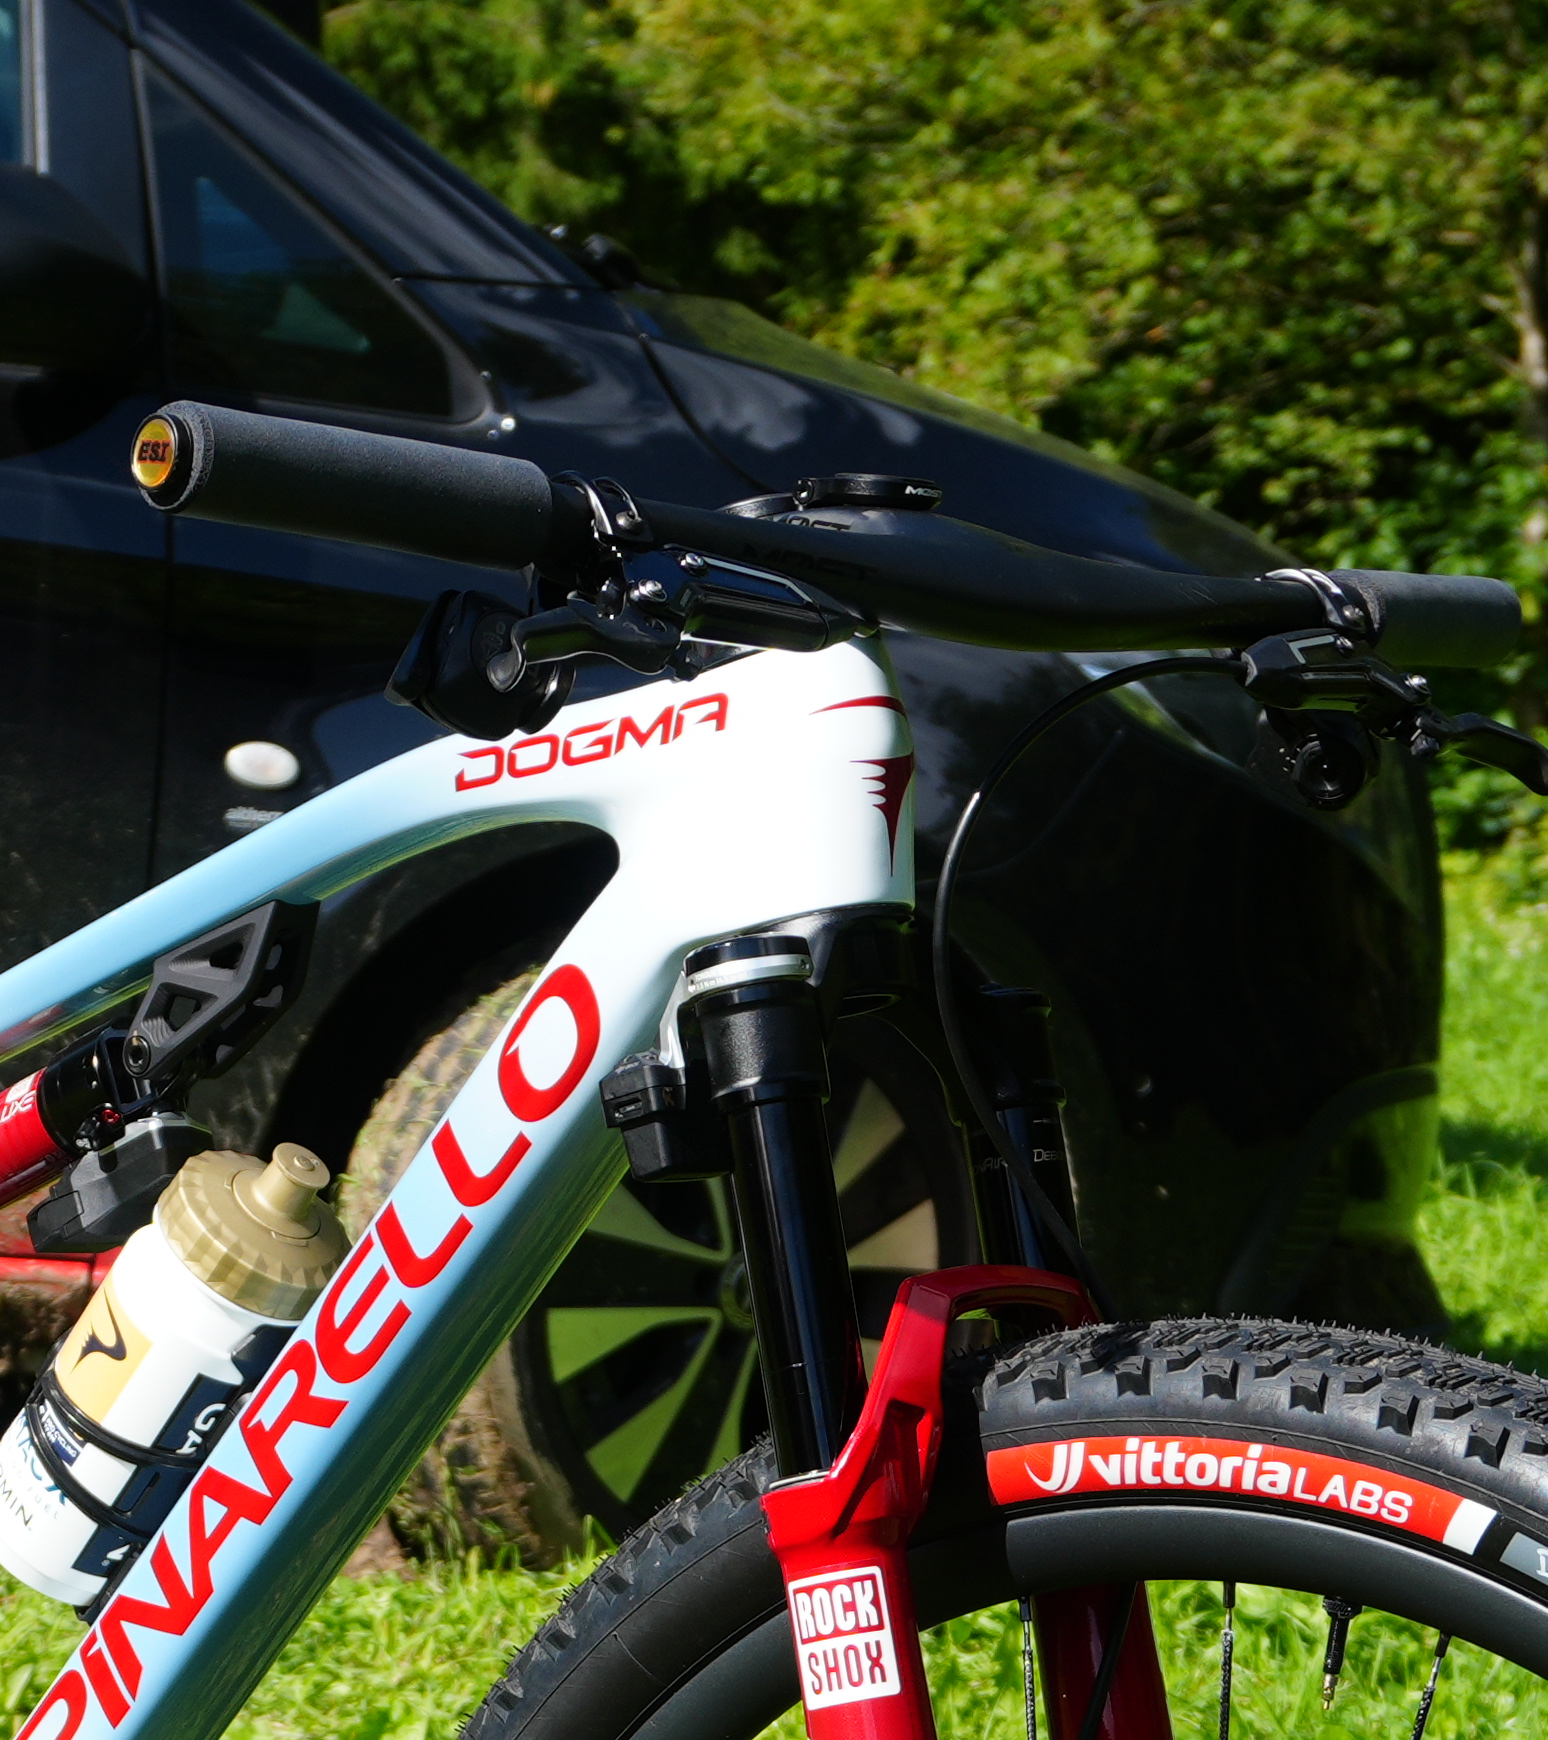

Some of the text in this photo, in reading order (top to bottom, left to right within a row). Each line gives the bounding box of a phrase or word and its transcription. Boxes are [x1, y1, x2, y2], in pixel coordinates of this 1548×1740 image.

[138, 442, 170, 461] ESI
[455, 692, 729, 793] DOGMA
[795, 1579, 879, 1640] ROCK
[808, 1640, 887, 1695] SHOX
